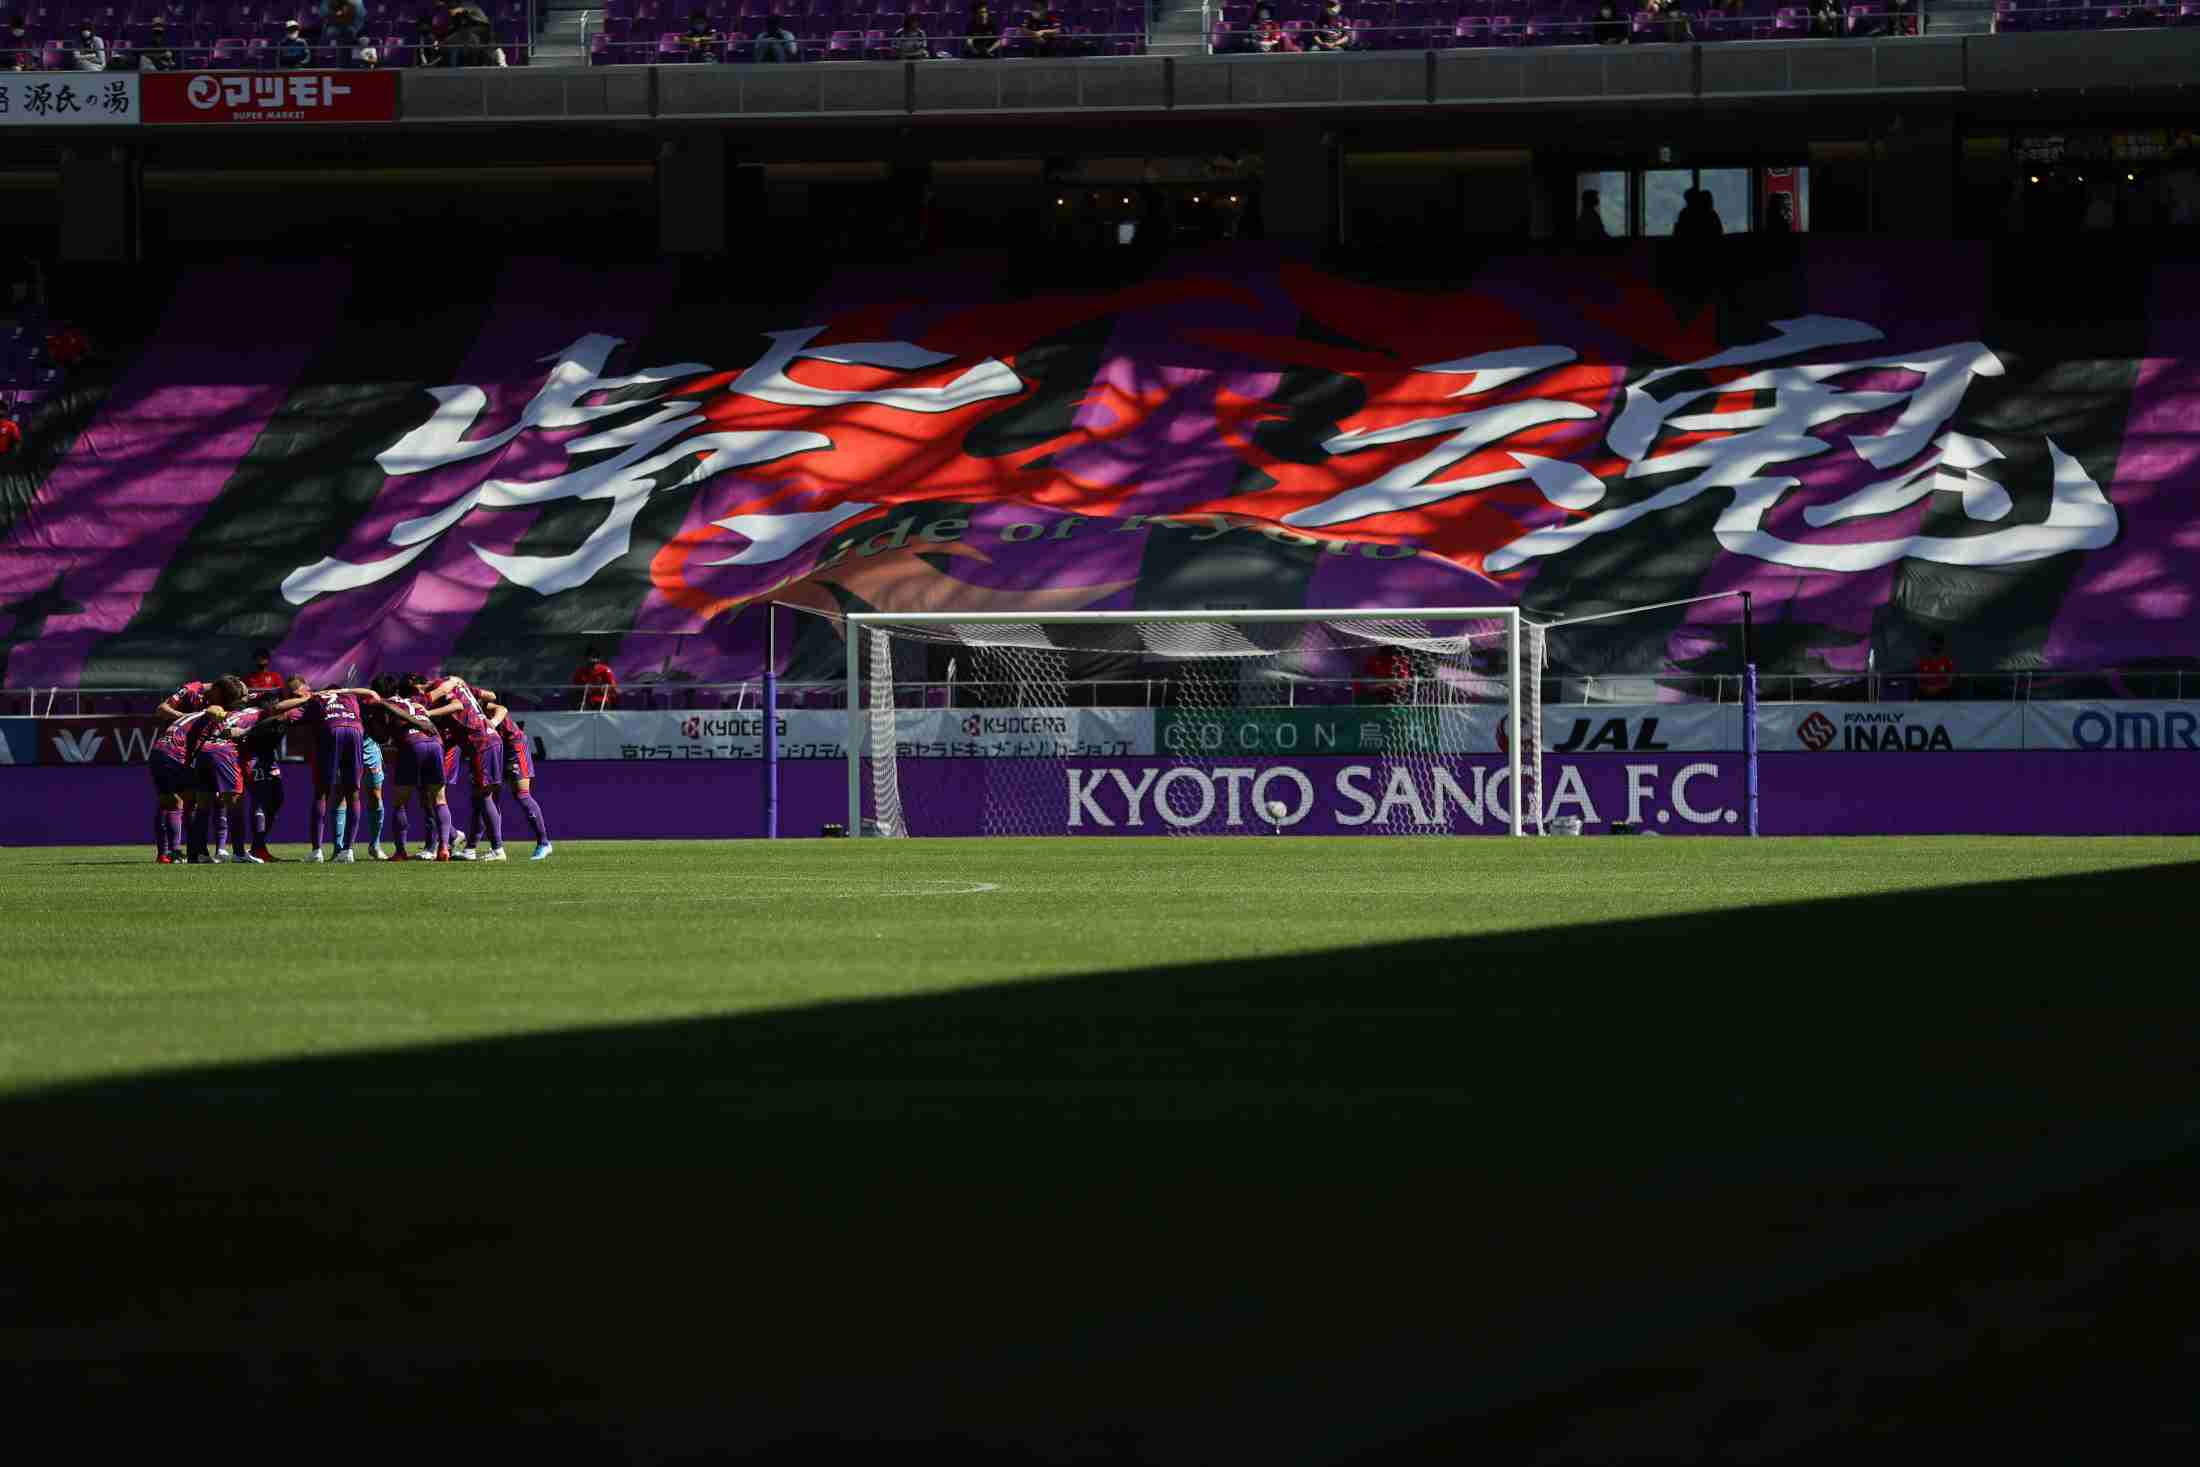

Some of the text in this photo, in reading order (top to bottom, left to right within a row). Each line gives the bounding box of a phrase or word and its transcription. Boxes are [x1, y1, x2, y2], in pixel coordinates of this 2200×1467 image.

[223, 76, 352, 107] マツモト
[232, 111, 306, 120] SUPER MARKET
[703, 718, 788, 736] KYOCEA
[1844, 712, 1905, 723] FAMILY
[1553, 717, 1669, 752] JAL
[1844, 724, 1954, 752] INADA
[1067, 766, 1314, 827] KYOTO
[1624, 763, 1738, 824] F.C.
